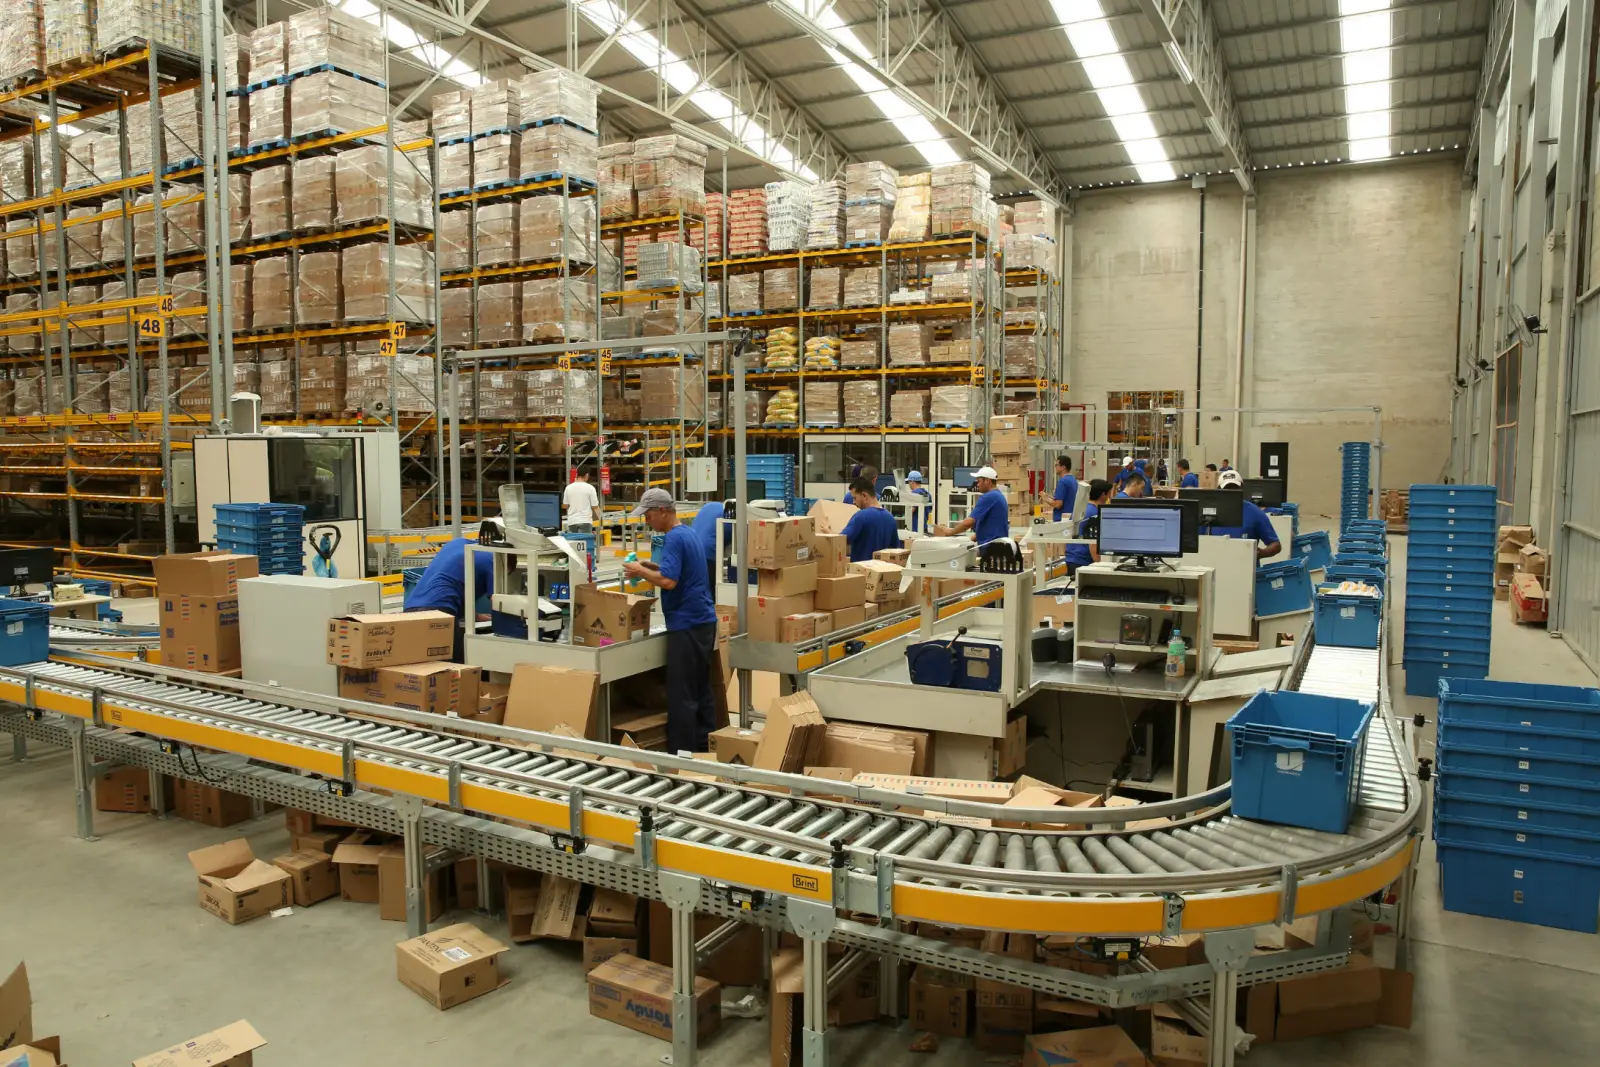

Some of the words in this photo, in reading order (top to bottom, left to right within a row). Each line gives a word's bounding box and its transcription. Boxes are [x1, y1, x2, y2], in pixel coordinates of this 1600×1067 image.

[162, 298, 173, 312] 48
[141, 318, 160, 333] 48
[394, 325, 404, 336] 47
[381, 342, 393, 353] 47
[602, 350, 611, 358] 45
[559, 360, 568, 370] 46
[601, 363, 610, 373] 45
[577, 542, 585, 551] 01
[795, 877, 815, 889] Brint
[417, 936, 443, 954] PANTENE
